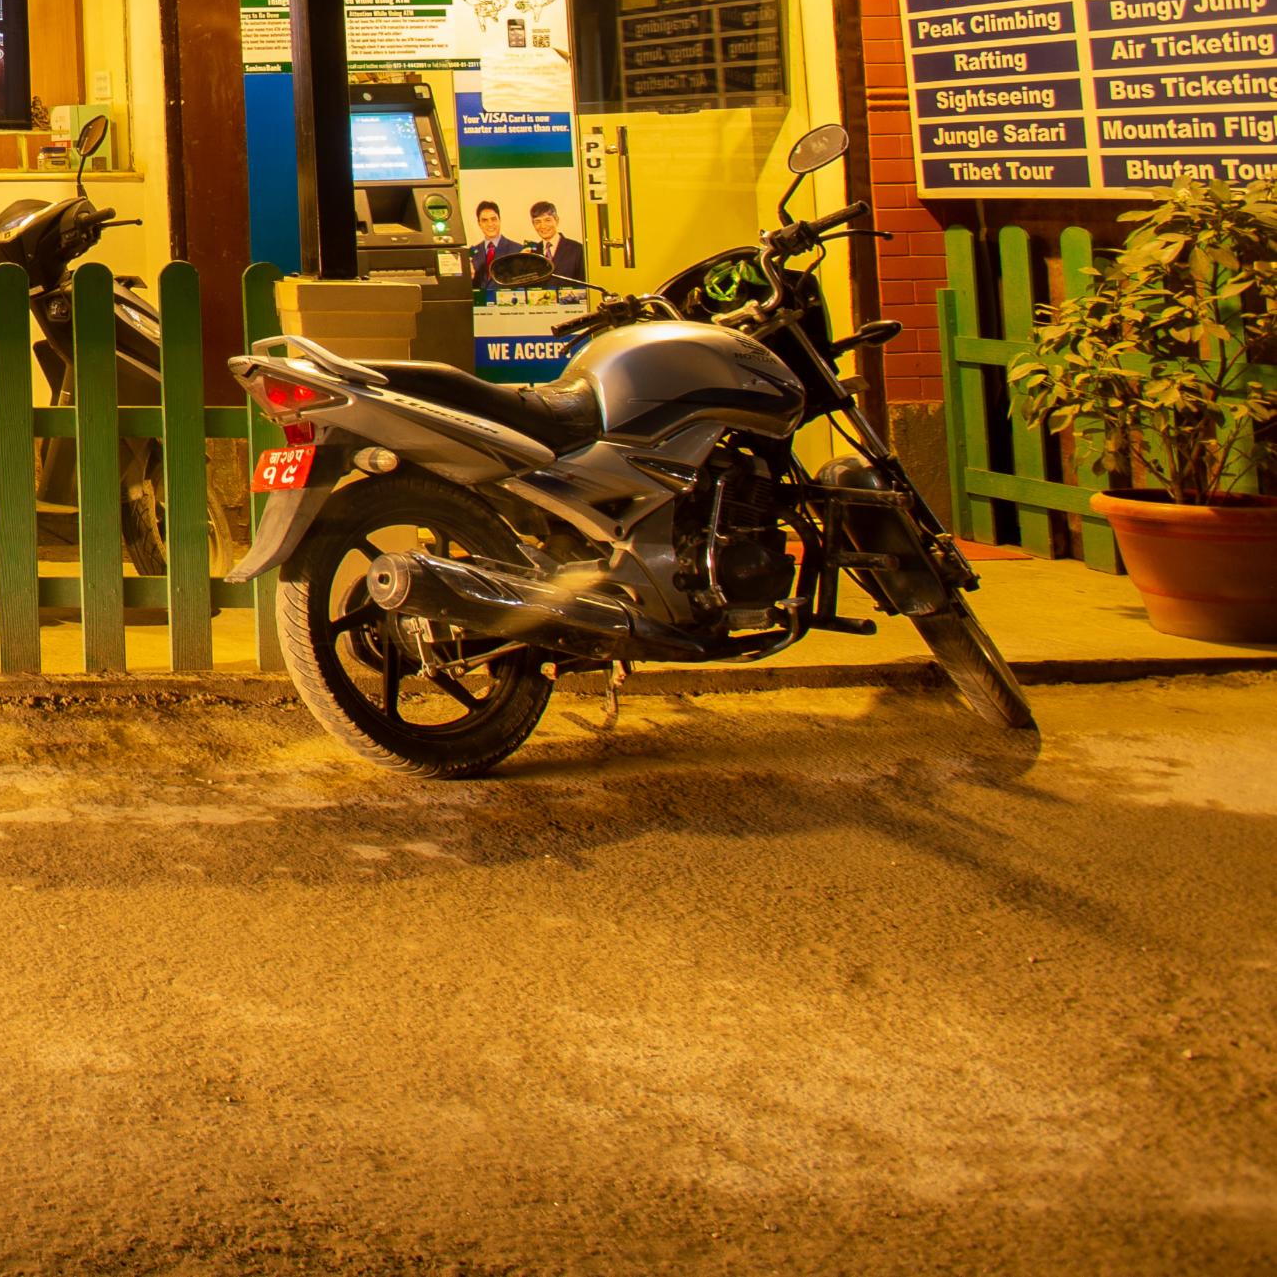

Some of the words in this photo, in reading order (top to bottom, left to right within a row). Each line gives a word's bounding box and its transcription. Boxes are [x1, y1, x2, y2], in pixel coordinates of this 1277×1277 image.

[917, 19, 965, 40] Peak
[970, 9, 1061, 34] Climbing
[1111, 39, 1145, 61] Air
[1151, 31, 1275, 58] Ticketing
[954, 50, 1028, 73] Rafting
[936, 86, 1055, 112] Sightseeing
[1109, 79, 1155, 101] Bus
[1159, 73, 1277, 100] Ticketing
[463, 115, 480, 124] Your
[479, 112, 508, 124] VISA
[508, 115, 525, 123] Card
[527, 114, 533, 122] is
[463, 126, 492, 134] smarter
[493, 125, 507, 134] and
[534, 124, 551, 132] than
[1102, 117, 1217, 141] Mountain
[933, 125, 998, 149] Jungle
[1003, 123, 1066, 144] Safari
[585, 141, 604, 201] PULL
[949, 162, 1002, 181] Tibet
[1005, 161, 1054, 181] Tour
[1126, 160, 1215, 180] Bhutan
[1221, 158, 1277, 181] Tou
[487, 343, 510, 361] WE
